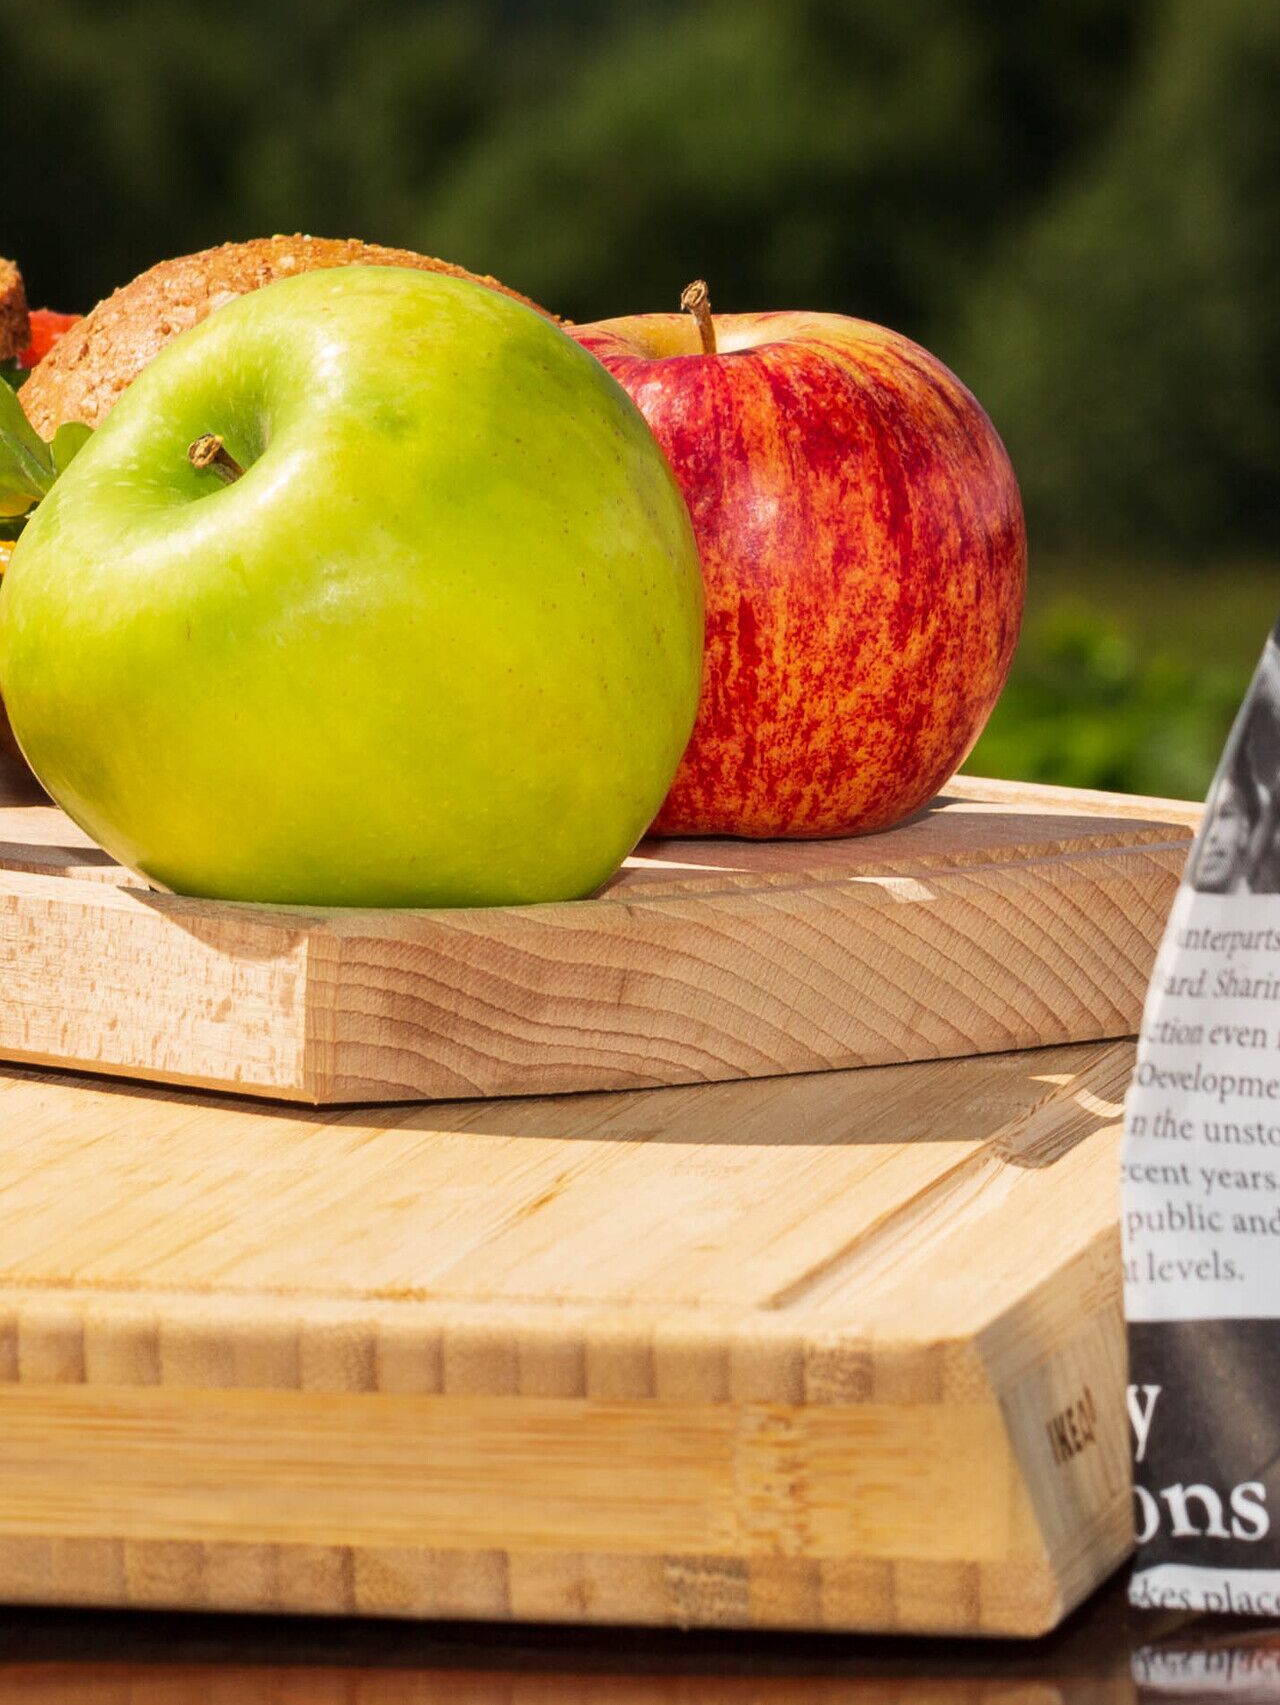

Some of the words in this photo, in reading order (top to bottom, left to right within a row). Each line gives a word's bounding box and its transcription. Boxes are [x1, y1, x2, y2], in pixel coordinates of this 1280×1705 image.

[1209, 1022, 1268, 1049] even
[1152, 1107, 1195, 1141] the
[1126, 1201, 1223, 1241] public
[1146, 1248, 1246, 1284] levels.
